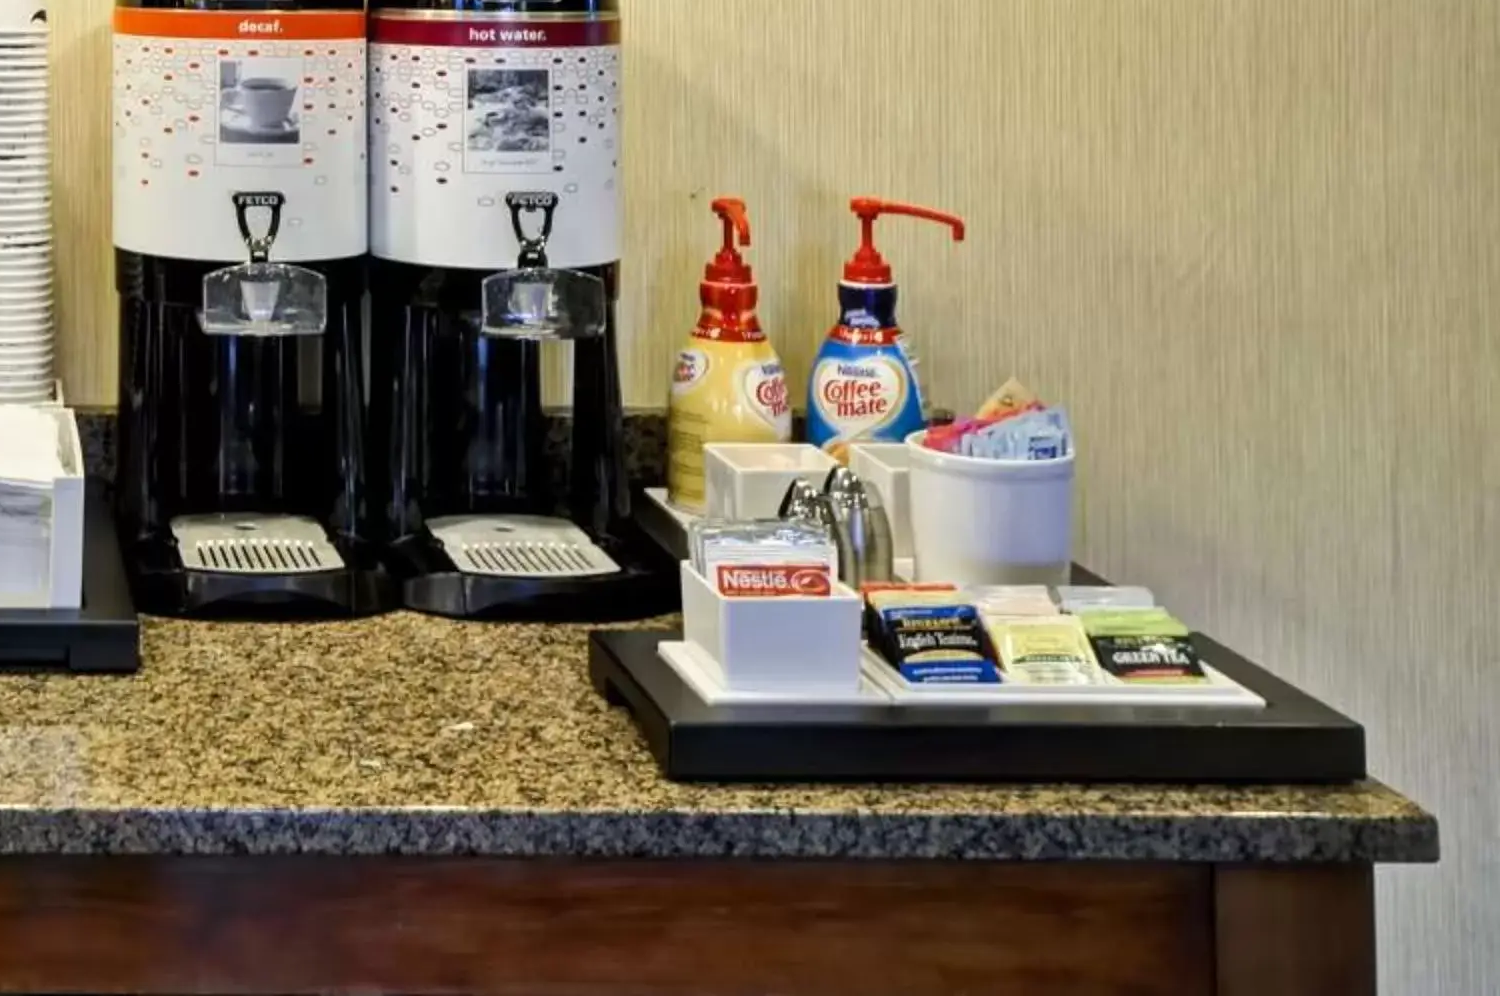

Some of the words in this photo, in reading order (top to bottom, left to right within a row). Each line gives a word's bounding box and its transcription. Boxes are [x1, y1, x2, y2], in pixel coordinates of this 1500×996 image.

[238, 19, 283, 34] decaf.
[468, 26, 496, 41] hot
[499, 28, 548, 42] water.
[237, 194, 279, 206] FETCO
[824, 379, 882, 404] Coffee
[836, 398, 888, 417] mate
